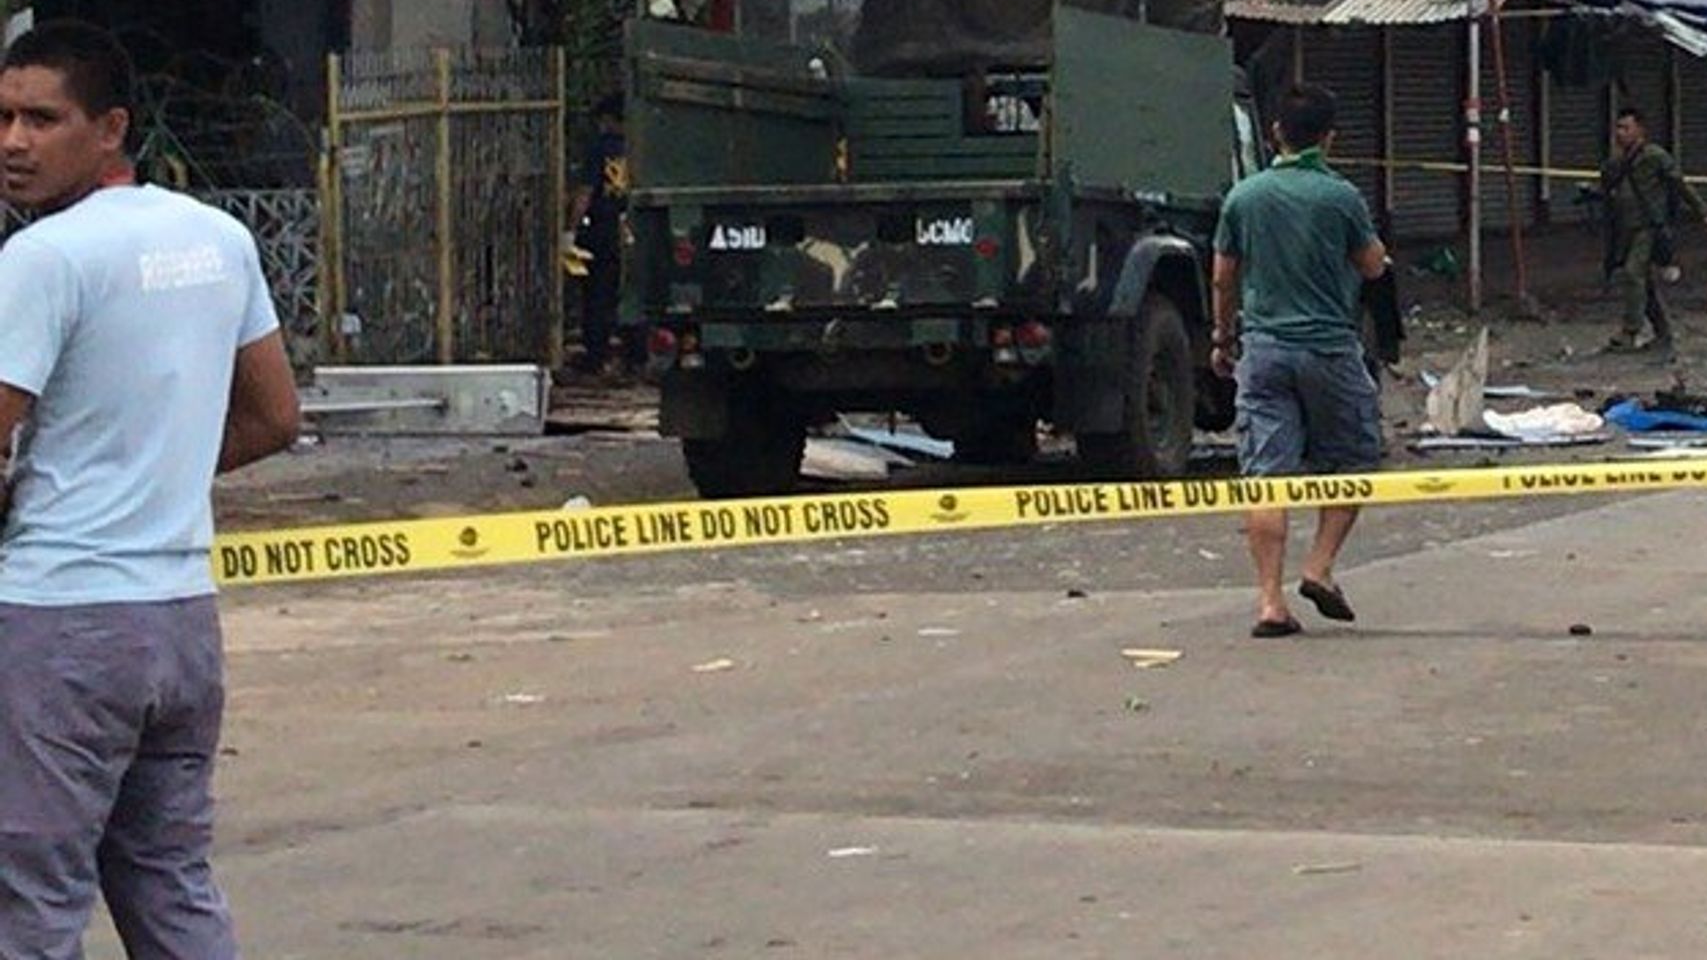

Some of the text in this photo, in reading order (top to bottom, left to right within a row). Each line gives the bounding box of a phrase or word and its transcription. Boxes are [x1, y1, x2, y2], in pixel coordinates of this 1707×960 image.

[1015, 487, 1108, 517] POLICE
[1117, 483, 1174, 510] LINE
[535, 499, 890, 552] POLICE LINE DO NOT CROSS
[221, 533, 411, 578] DO NOT CROSS
